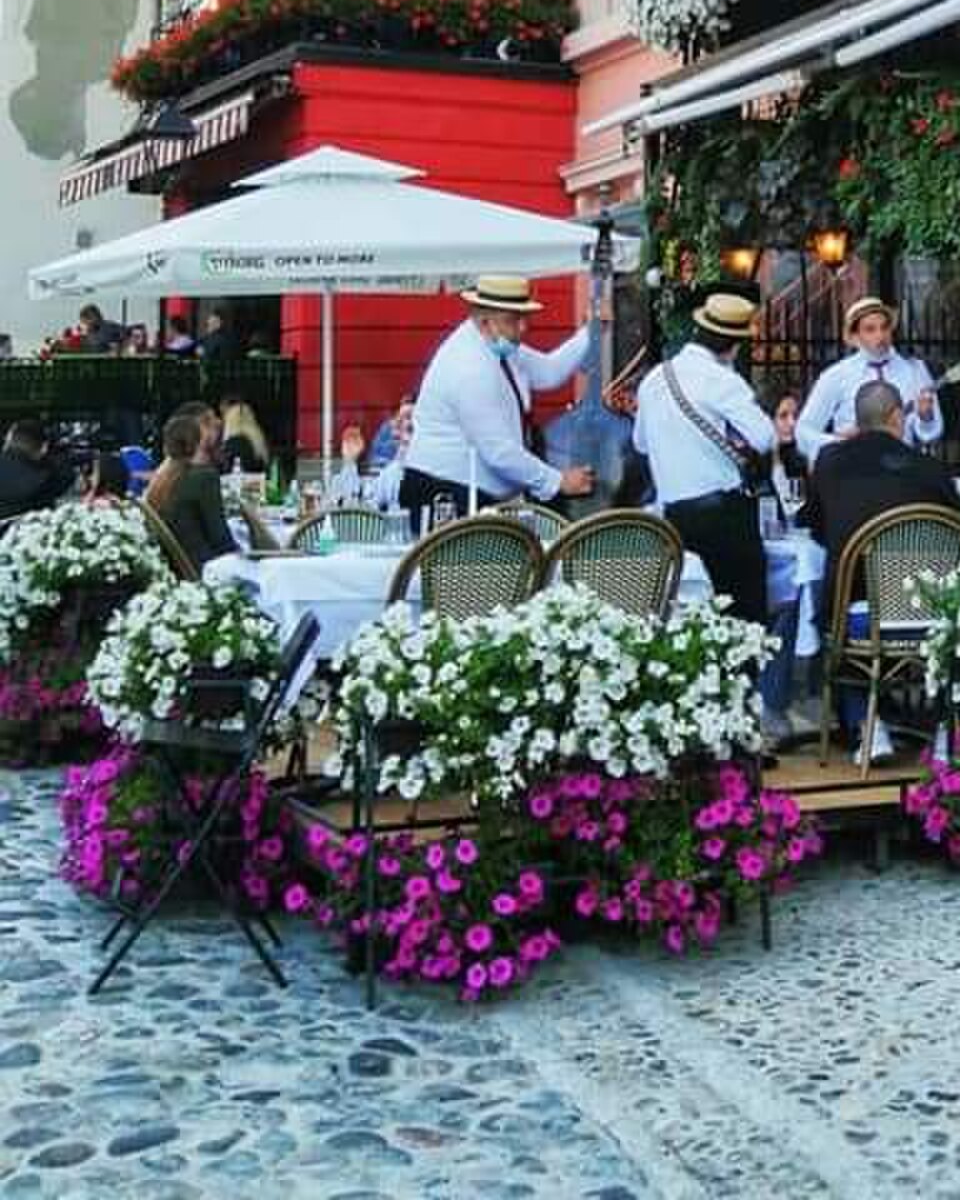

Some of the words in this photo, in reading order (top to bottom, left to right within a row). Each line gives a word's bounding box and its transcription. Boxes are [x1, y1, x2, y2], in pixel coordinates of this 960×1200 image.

[274, 254, 312, 267] OPEN
[316, 254, 335, 265] TO
[337, 253, 374, 264] MORE
